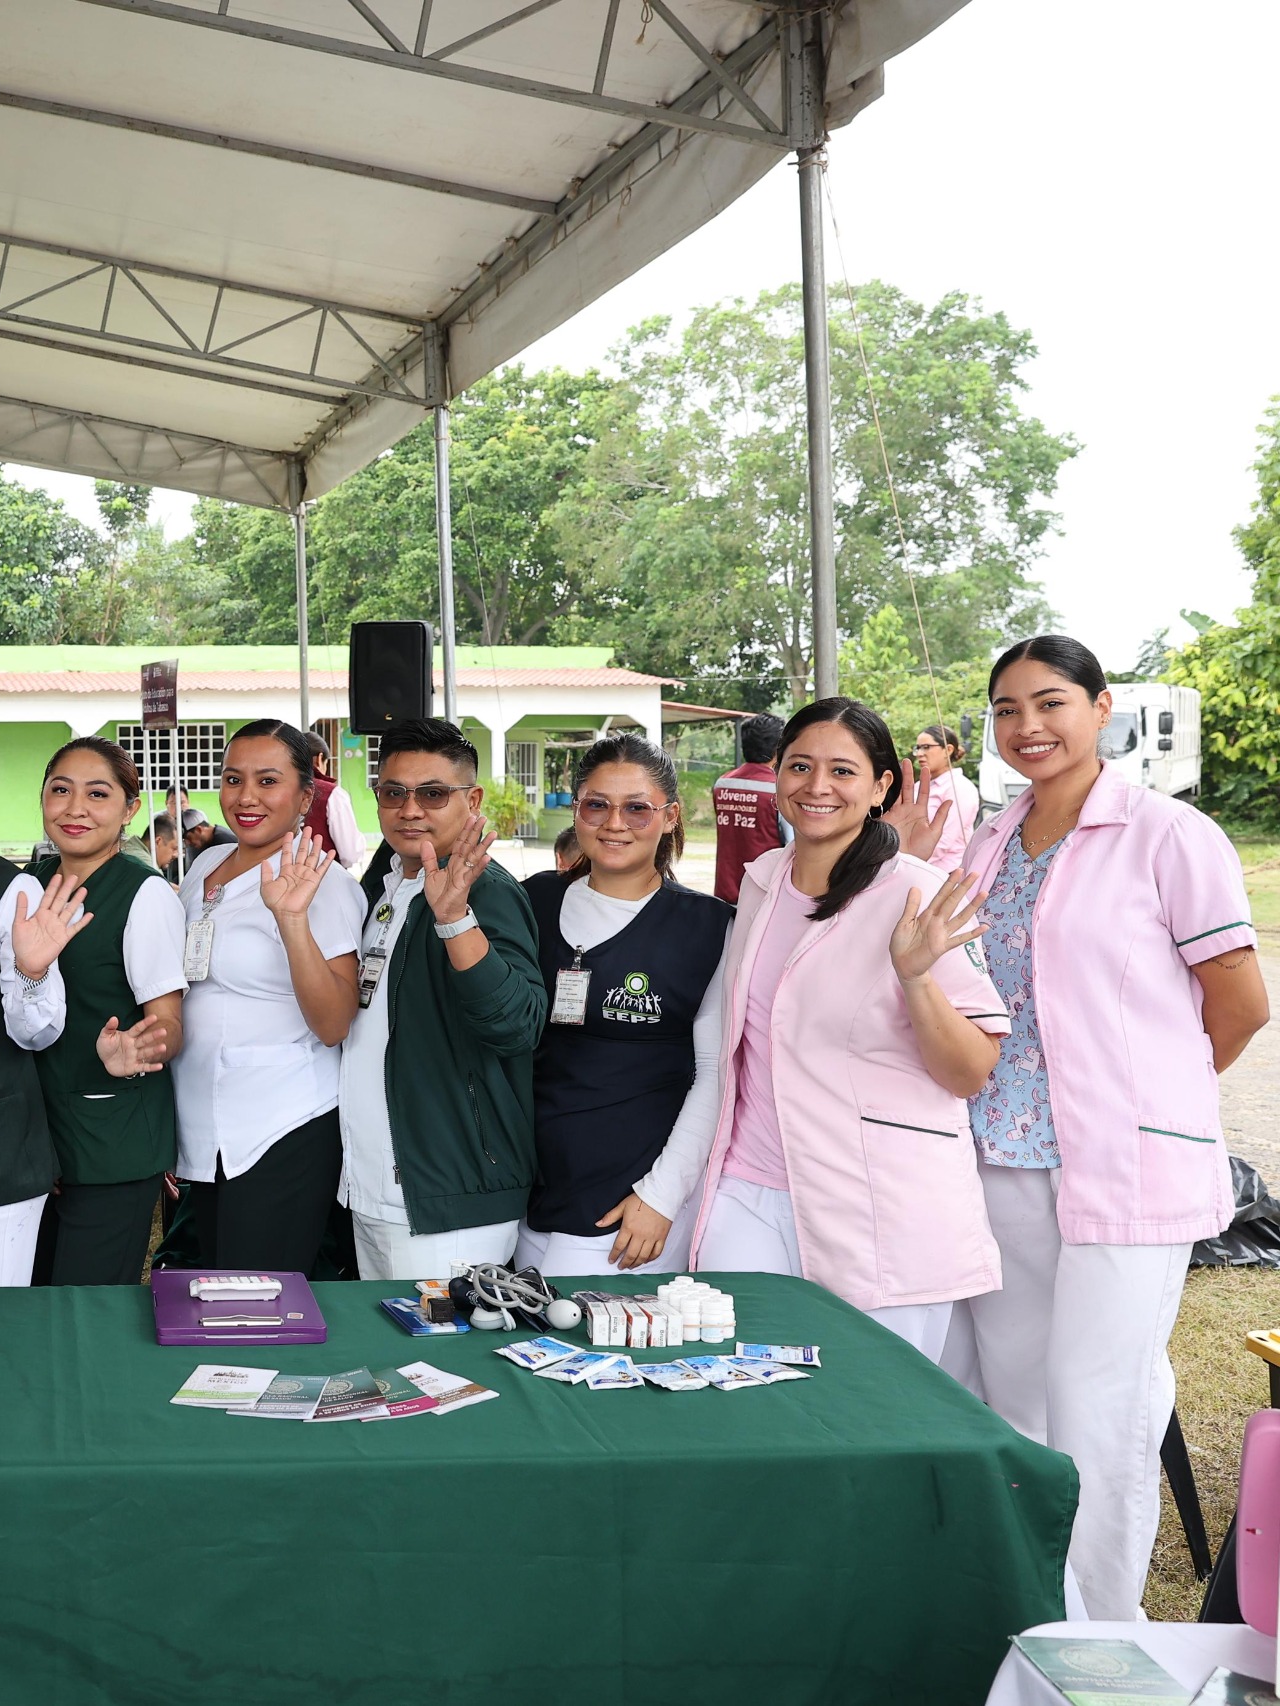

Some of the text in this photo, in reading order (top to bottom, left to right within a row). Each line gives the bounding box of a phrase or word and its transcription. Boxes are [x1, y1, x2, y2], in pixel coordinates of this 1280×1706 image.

[717, 789, 758, 803] Jóvenes
[717, 812, 756, 828] de Paz
[602, 1009, 661, 1024] EEPS
